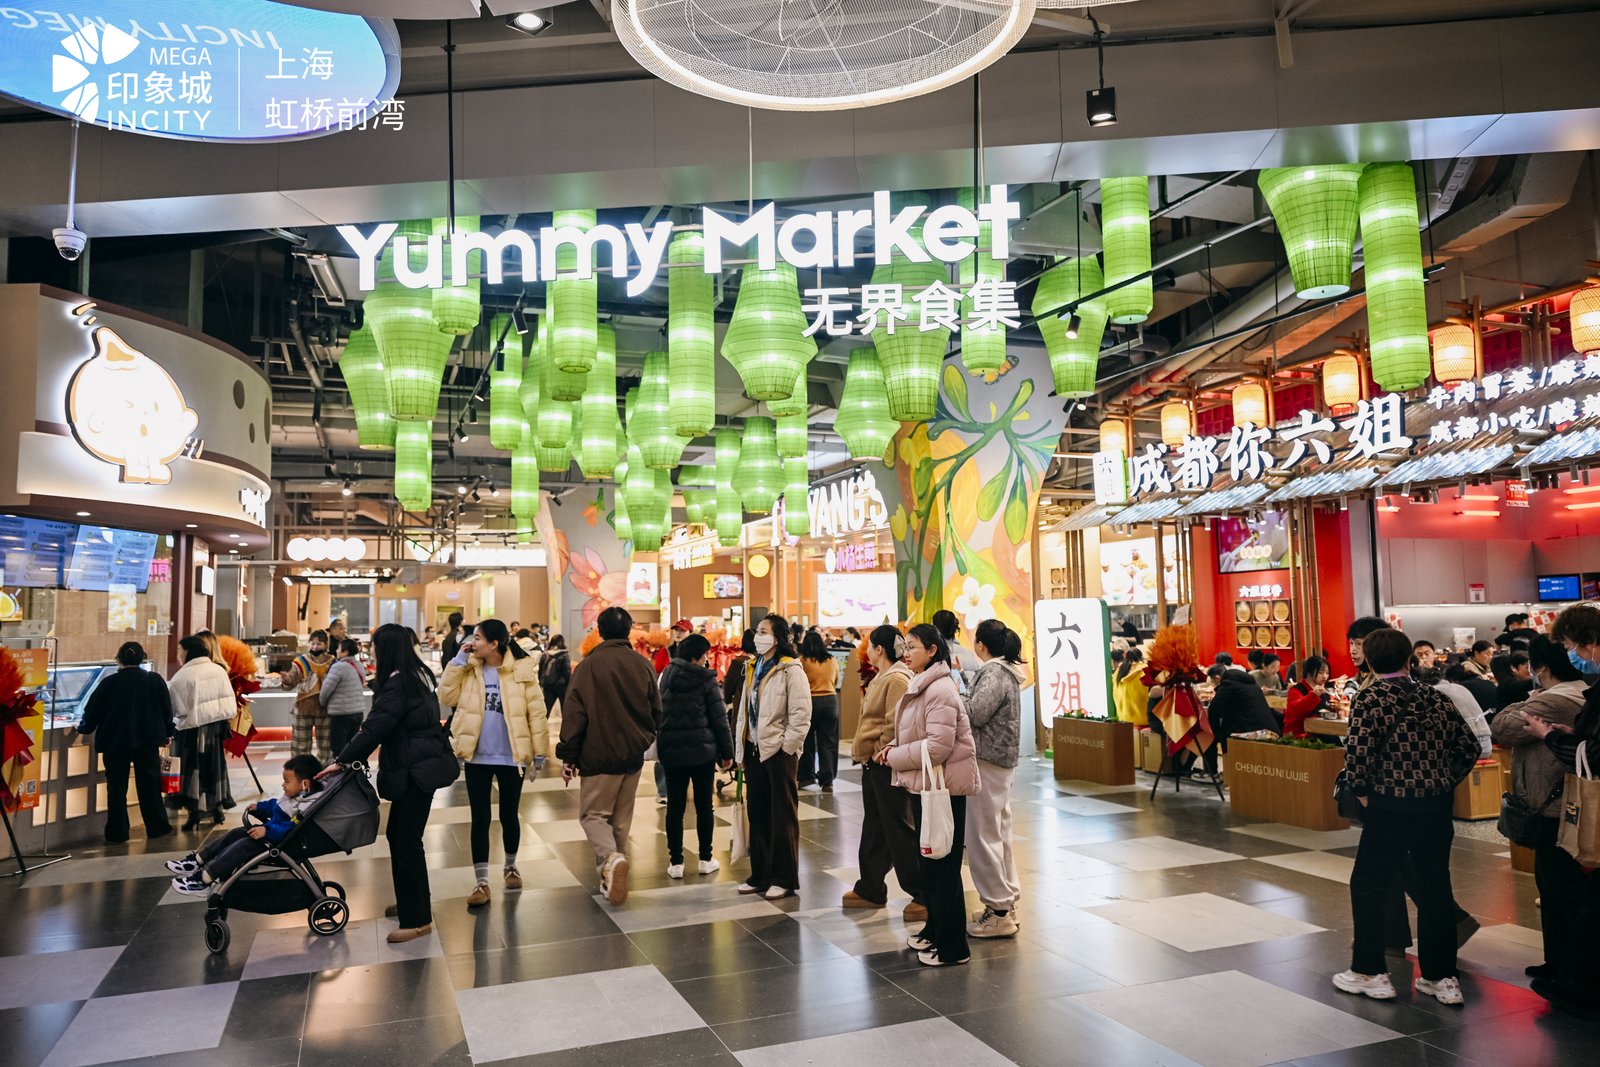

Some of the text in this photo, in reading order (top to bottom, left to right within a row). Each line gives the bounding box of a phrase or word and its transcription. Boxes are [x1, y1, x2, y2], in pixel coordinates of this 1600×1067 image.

[335, 184, 1021, 298] Yummy Market
[801, 277, 1021, 338] 无界食集
[1130, 392, 1413, 497] 成都你六姐
[1047, 611, 1089, 717] 六姐
[1285, 770, 1310, 783] LIUJIE
